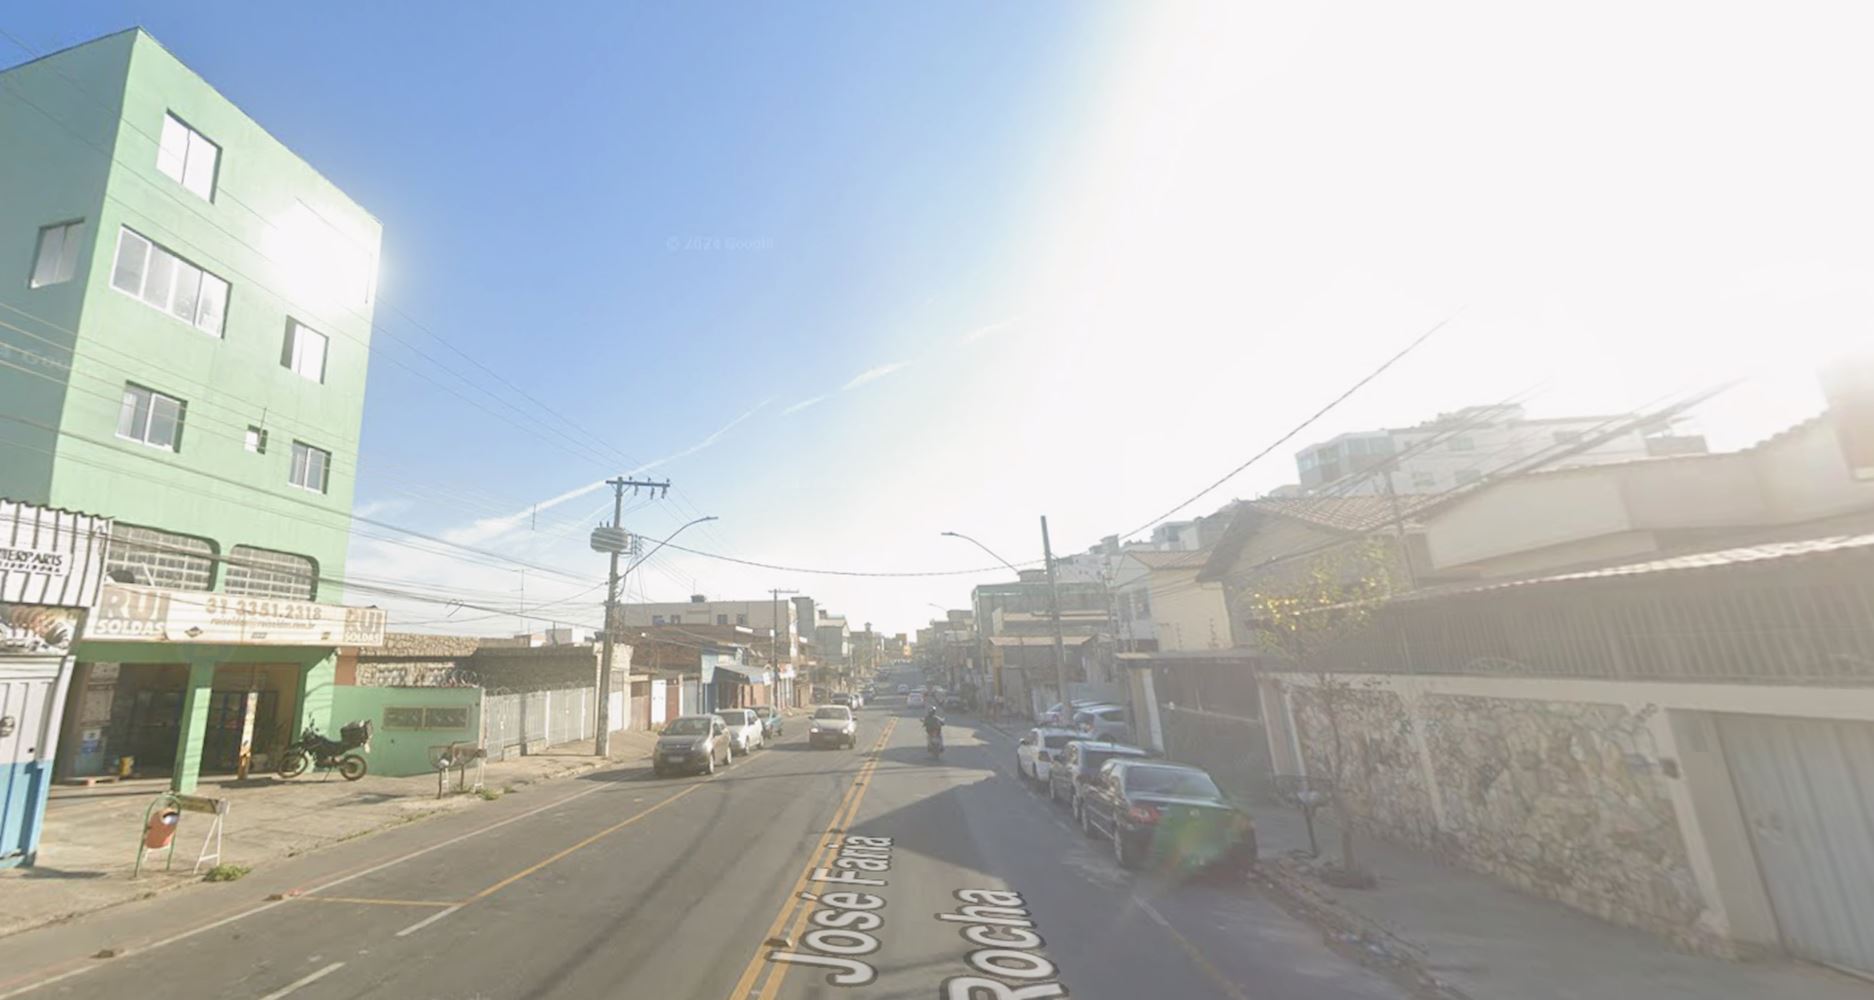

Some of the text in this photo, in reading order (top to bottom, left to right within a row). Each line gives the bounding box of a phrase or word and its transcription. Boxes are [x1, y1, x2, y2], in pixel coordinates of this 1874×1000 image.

[99, 588, 170, 620] RUI
[206, 598, 323, 620] 31 3351.2318
[95, 619, 167, 636] SOLDAS
[344, 609, 383, 633] RUI
